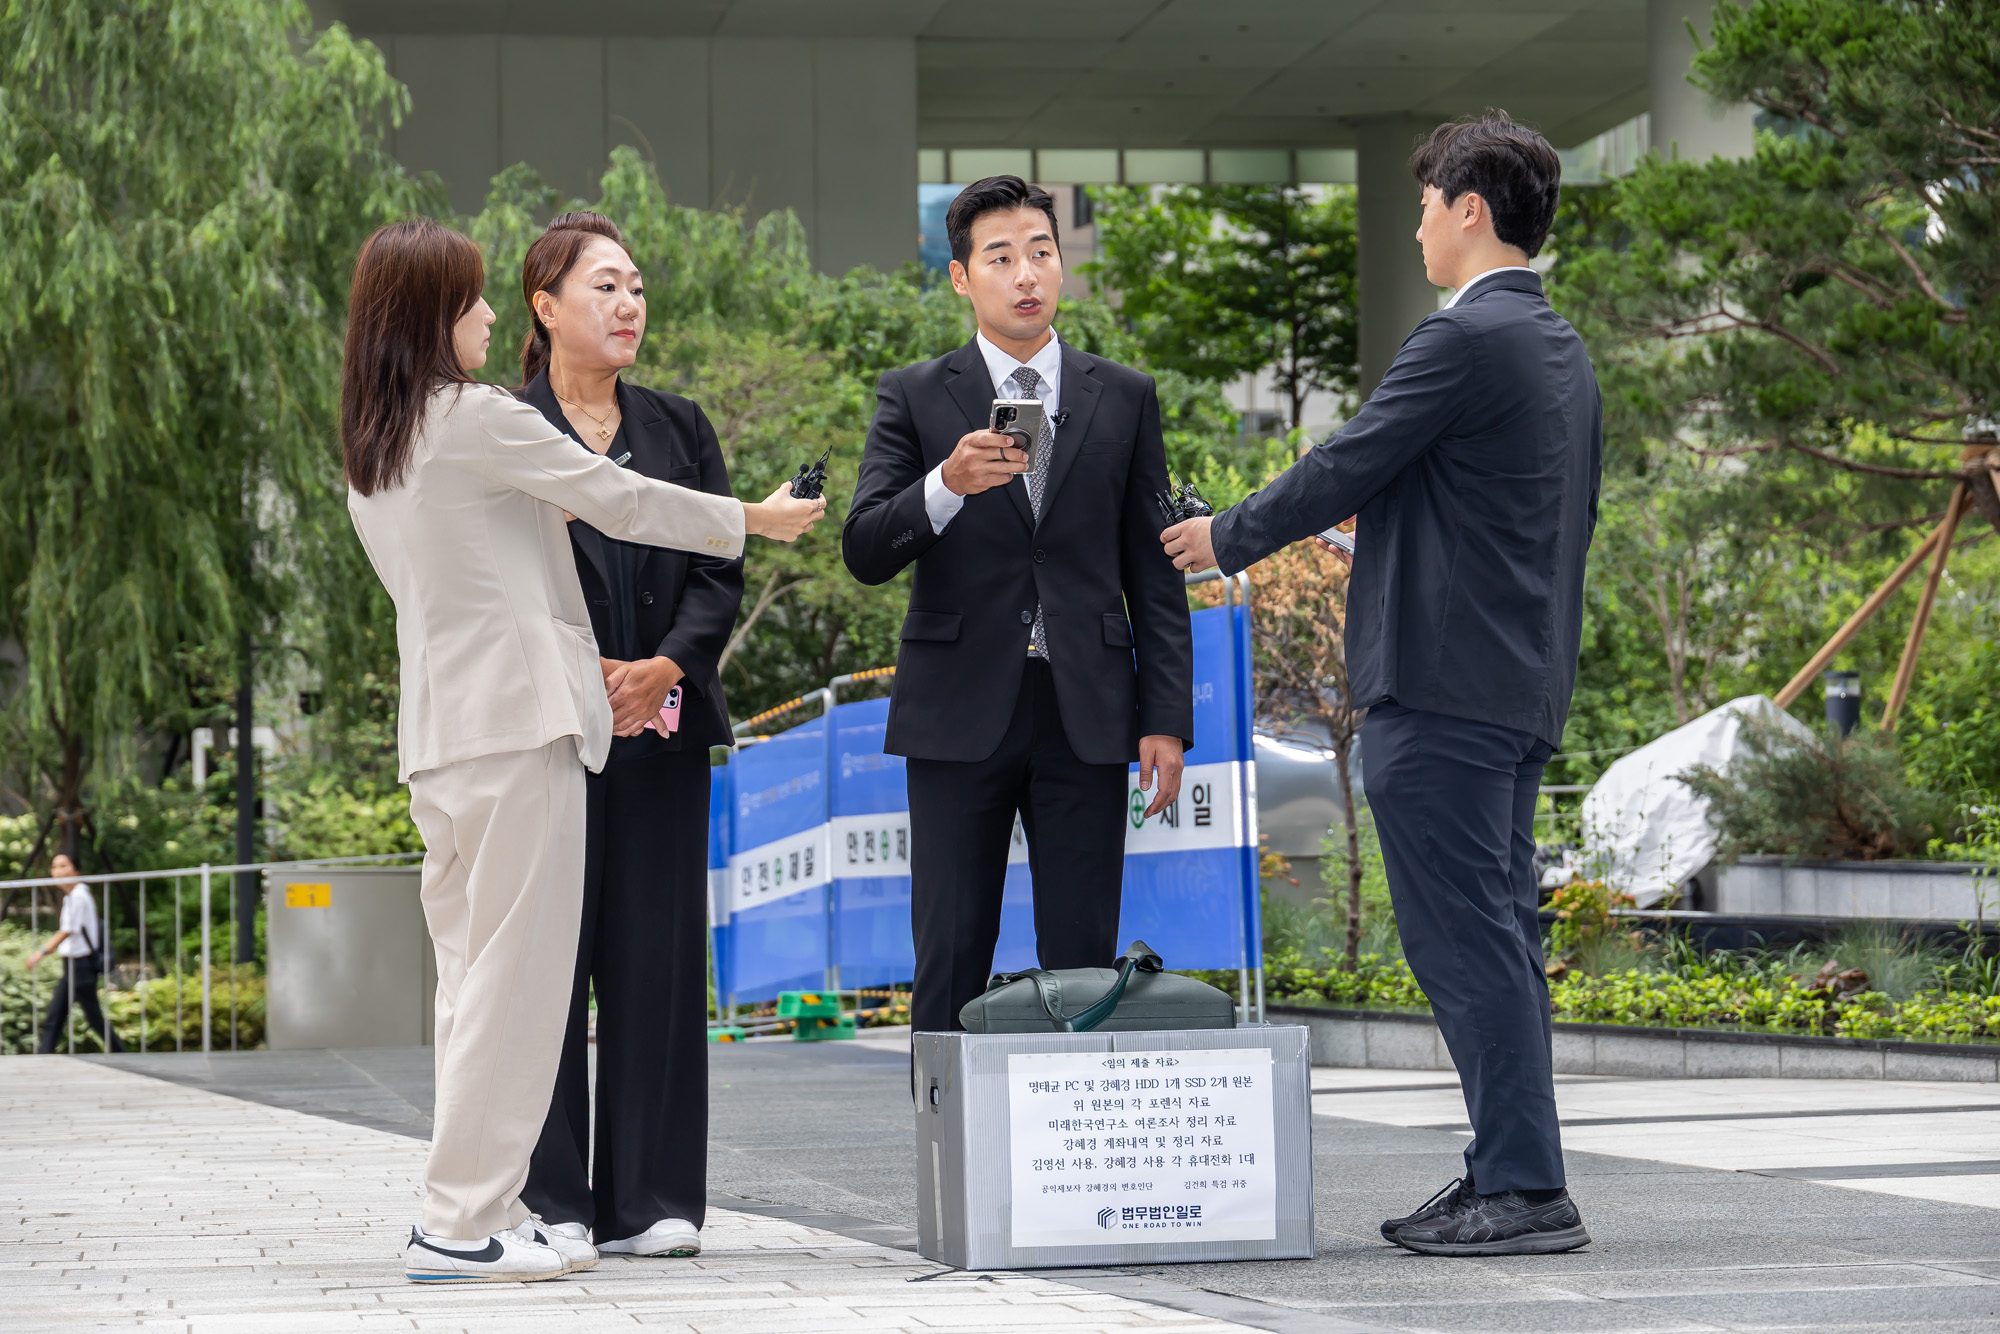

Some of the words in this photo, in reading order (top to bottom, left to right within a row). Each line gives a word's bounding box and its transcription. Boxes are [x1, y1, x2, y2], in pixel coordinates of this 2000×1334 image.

[788, 846, 815, 881] 제일
[1131, 1058, 1150, 1068] 제출
[1029, 1081, 1060, 1093] 명태균
[1065, 1081, 1079, 1090] PC
[1084, 1080, 1094, 1092] 및
[1100, 1079, 1130, 1092] 강혜경
[1136, 1079, 1159, 1089] HDD
[1165, 1078, 1180, 1089] 1개
[1185, 1078, 1206, 1088] SSD
[1211, 1076, 1227, 1088] 2개
[1232, 1076, 1253, 1088] 원본
[1074, 1099, 1083, 1111] 위
[1091, 1098, 1124, 1111] 원본의
[1131, 1098, 1142, 1110] 각
[1149, 1097, 1181, 1109] 포렌식
[1189, 1096, 1211, 1108] 자료
[1049, 1118, 1128, 1131] 미래한국연구소
[1135, 1116, 1180, 1129] 여론조사
[1186, 1116, 1207, 1128] 정리
[1215, 1115, 1237, 1127] 자료
[1063, 1138, 1096, 1151] 강혜경
[1104, 1137, 1148, 1149] 계좌내역
[1156, 1136, 1165, 1148] 및
[1173, 1136, 1194, 1148] 정리
[1201, 1135, 1223, 1147] 자료
[1032, 1158, 1064, 1171] 김영선
[1104, 1157, 1136, 1169] 강혜경
[1143, 1156, 1165, 1168] 사용
[1171, 1155, 1182, 1167] 각
[1188, 1154, 1232, 1167] 휴대전화
[1239, 1153, 1254, 1165] 1대
[1042, 1184, 1081, 1193] 공익제보자
[1086, 1183, 1116, 1192] 강혜경의
[1122, 1182, 1152, 1191] 변호인단
[1184, 1180, 1206, 1189] 김건희
[1211, 1180, 1226, 1188] 특검
[1232, 1180, 1247, 1188] 귀중
[1122, 1205, 1202, 1221] 법무법인일로
